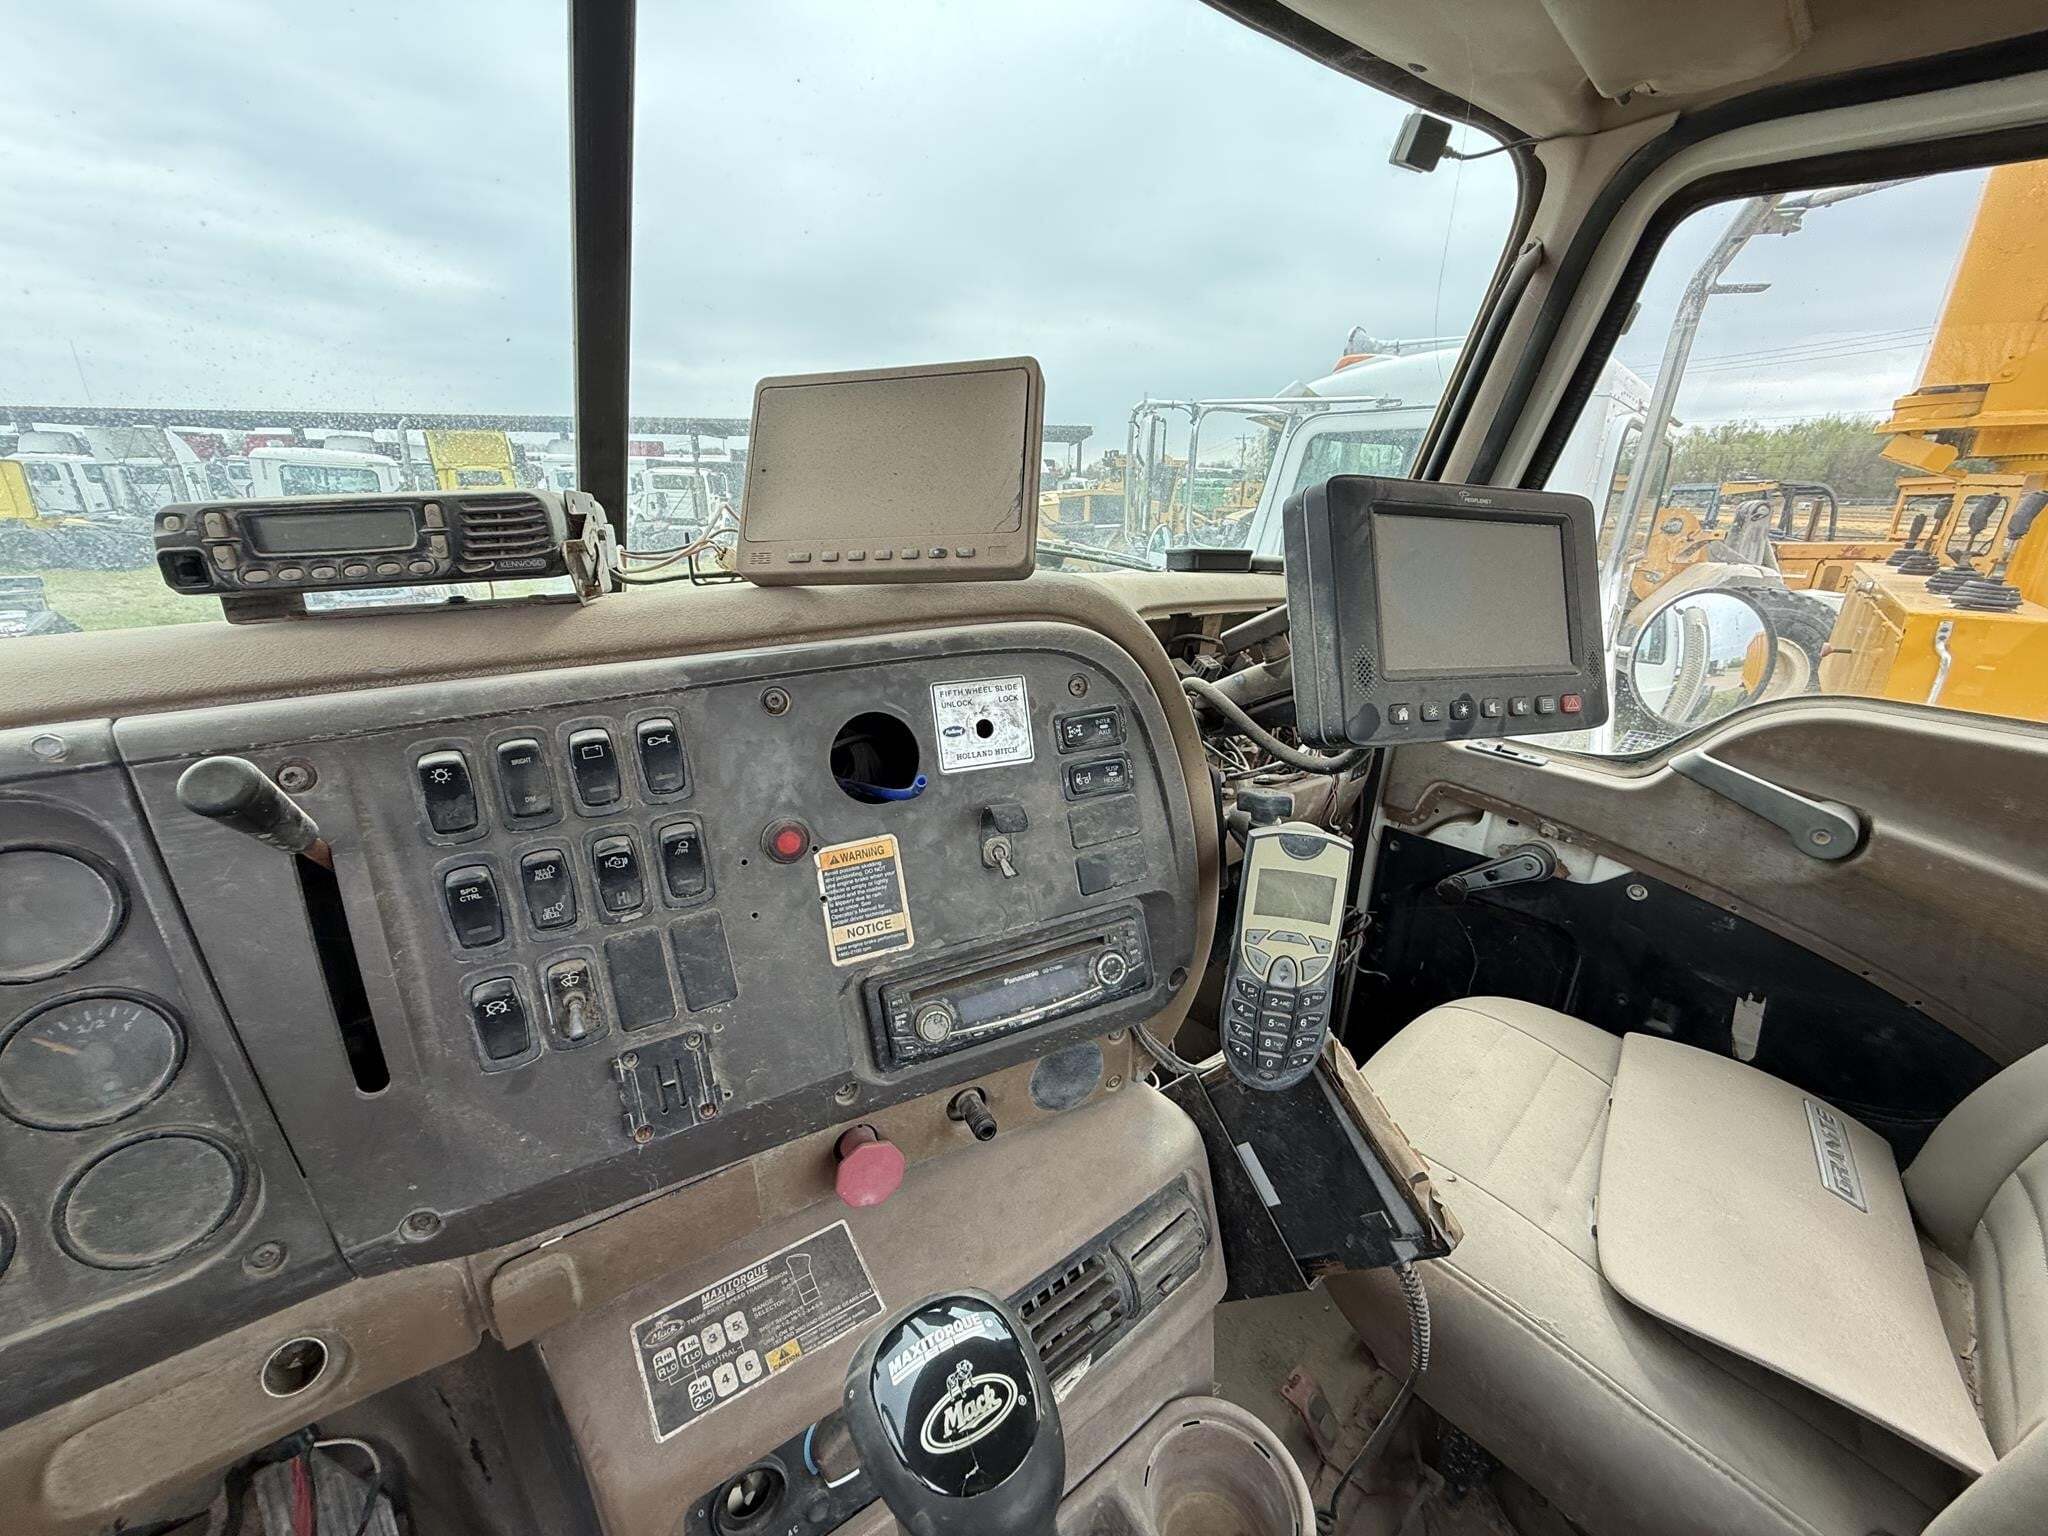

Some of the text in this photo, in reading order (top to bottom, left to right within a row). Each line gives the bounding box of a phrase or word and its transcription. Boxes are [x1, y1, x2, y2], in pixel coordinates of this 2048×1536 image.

[500, 559, 544, 568] KENWOOD
[940, 683, 1018, 697] FIFTH WHEEL SLIDE
[941, 699, 974, 708] UNLOCK
[956, 746, 1018, 760] HOLLAND HITCH
[511, 757, 531, 765] BRIGHT
[525, 795, 536, 803] DIM
[840, 845, 885, 862] WARNING
[873, 864, 886, 872] NOT
[534, 873, 553, 881] ACCEL
[460, 887, 478, 895] SPD
[460, 893, 483, 902] CTRL
[542, 911, 560, 920] DECEL
[847, 919, 893, 938] NOTICE
[1003, 968, 1040, 986] Panasonic
[1242, 983, 1246, 991] 1
[1271, 998, 1278, 1007] 2
[1303, 998, 1310, 1006] 3
[1237, 1004, 1244, 1013] 4
[1268, 1019, 1275, 1027] 5
[1300, 1018, 1307, 1027] 6
[1234, 1024, 1241, 1032] 7
[1264, 1038, 1271, 1047] 8
[1295, 1039, 1302, 1047] 9
[1266, 1059, 1273, 1068] 0
[1815, 1106, 1857, 1201] GRANITE
[701, 1263, 769, 1305] MAXITORQUE
[840, 1294, 859, 1307] GEARS
[858, 1287, 872, 1297] ONLY
[750, 1297, 774, 1312] RANGE
[752, 1298, 786, 1318] SELECTOR
[732, 1321, 740, 1332] 5
[651, 1324, 678, 1343] Mack
[709, 1333, 718, 1344] 3
[887, 1312, 983, 1376] MAXITORQUE
[700, 1346, 738, 1371] NEUTRAL
[773, 1353, 800, 1371] CAUTION
[744, 1360, 754, 1372] 6
[721, 1374, 731, 1385] 4
[942, 1384, 1003, 1439] Mack
